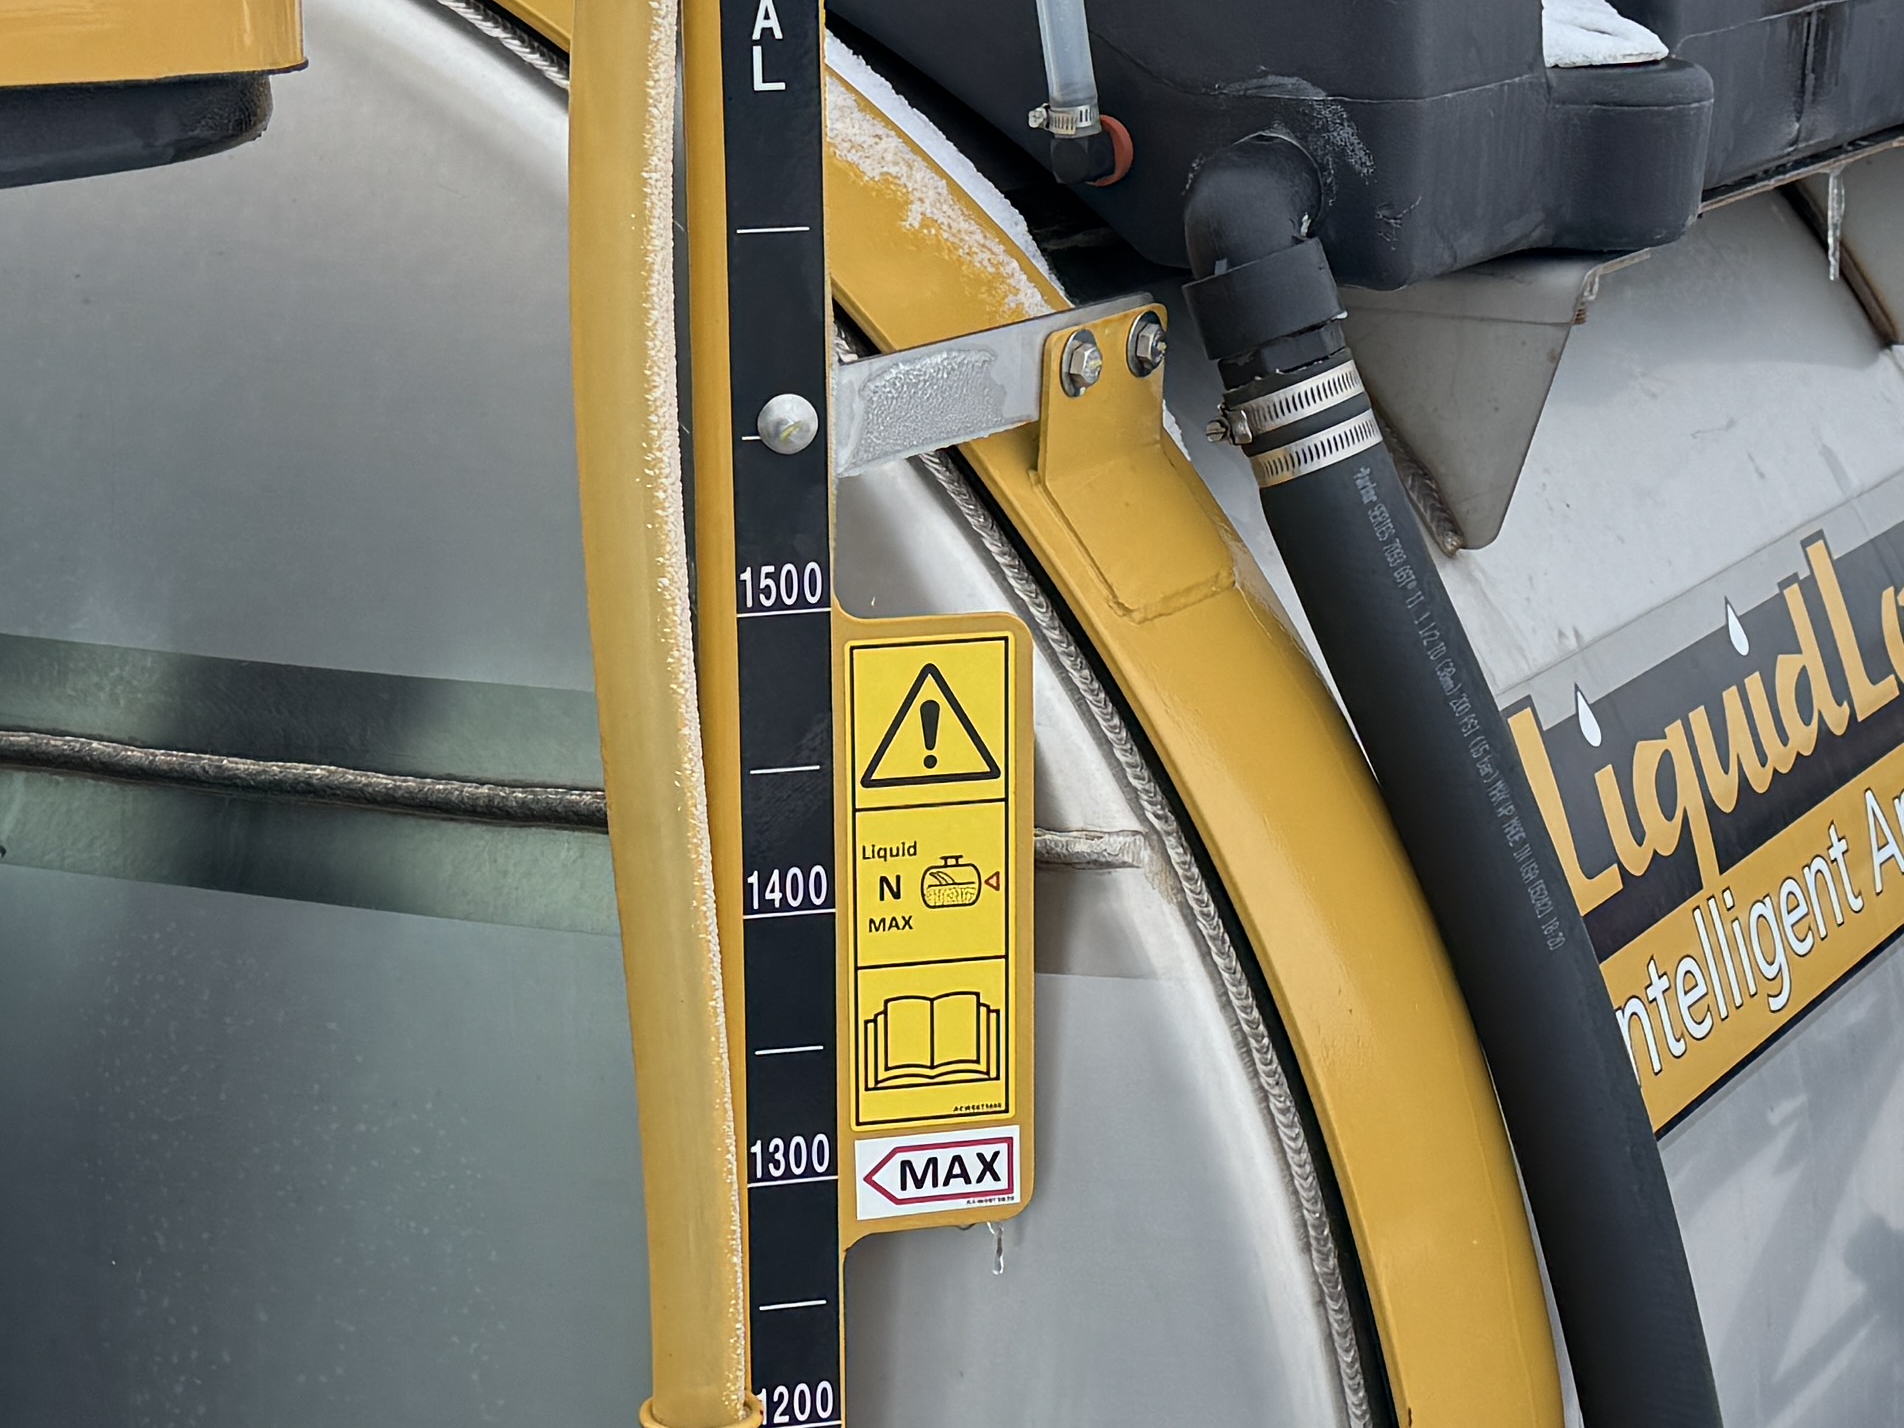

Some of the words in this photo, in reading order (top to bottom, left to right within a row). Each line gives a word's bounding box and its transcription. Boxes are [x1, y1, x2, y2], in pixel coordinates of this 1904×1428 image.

[739, 562, 824, 611] 1500
[862, 841, 917, 862] Liquid
[747, 866, 828, 909] 1400
[879, 874, 901, 901] N
[869, 915, 913, 933] MAX
[1615, 819, 1864, 1088] ntelligent
[750, 1132, 830, 1179] 1300
[900, 1150, 1001, 1191] MAX
[757, 1380, 834, 1426] 1200
